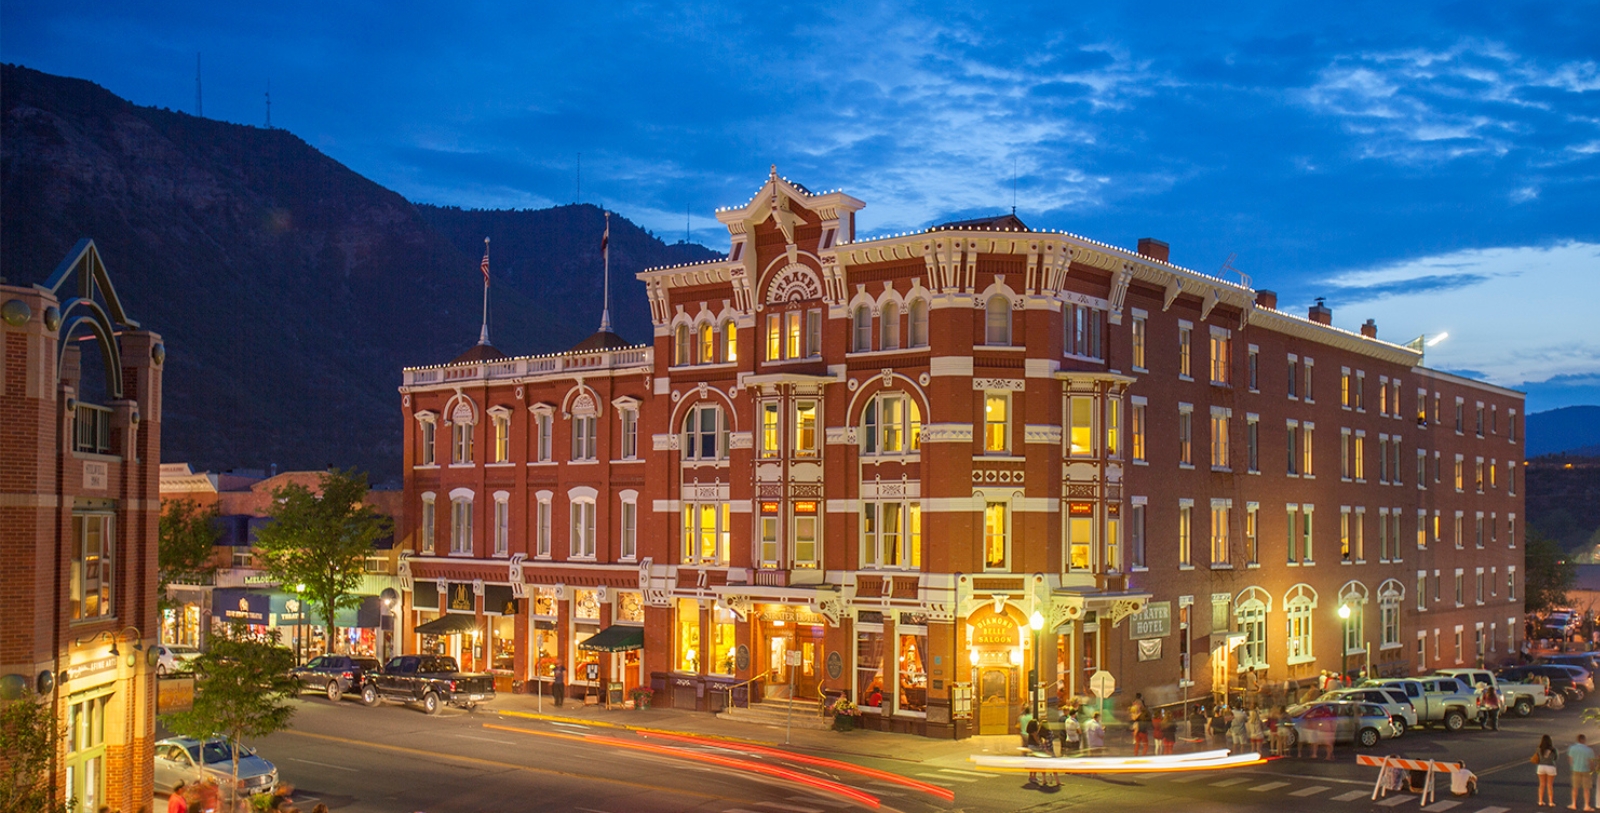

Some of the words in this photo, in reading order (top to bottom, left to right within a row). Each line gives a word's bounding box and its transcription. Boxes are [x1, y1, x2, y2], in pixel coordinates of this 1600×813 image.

[774, 271, 818, 301] STRATER
[977, 617, 1013, 629] DIAMOND
[1137, 620, 1164, 634] HOTEL
